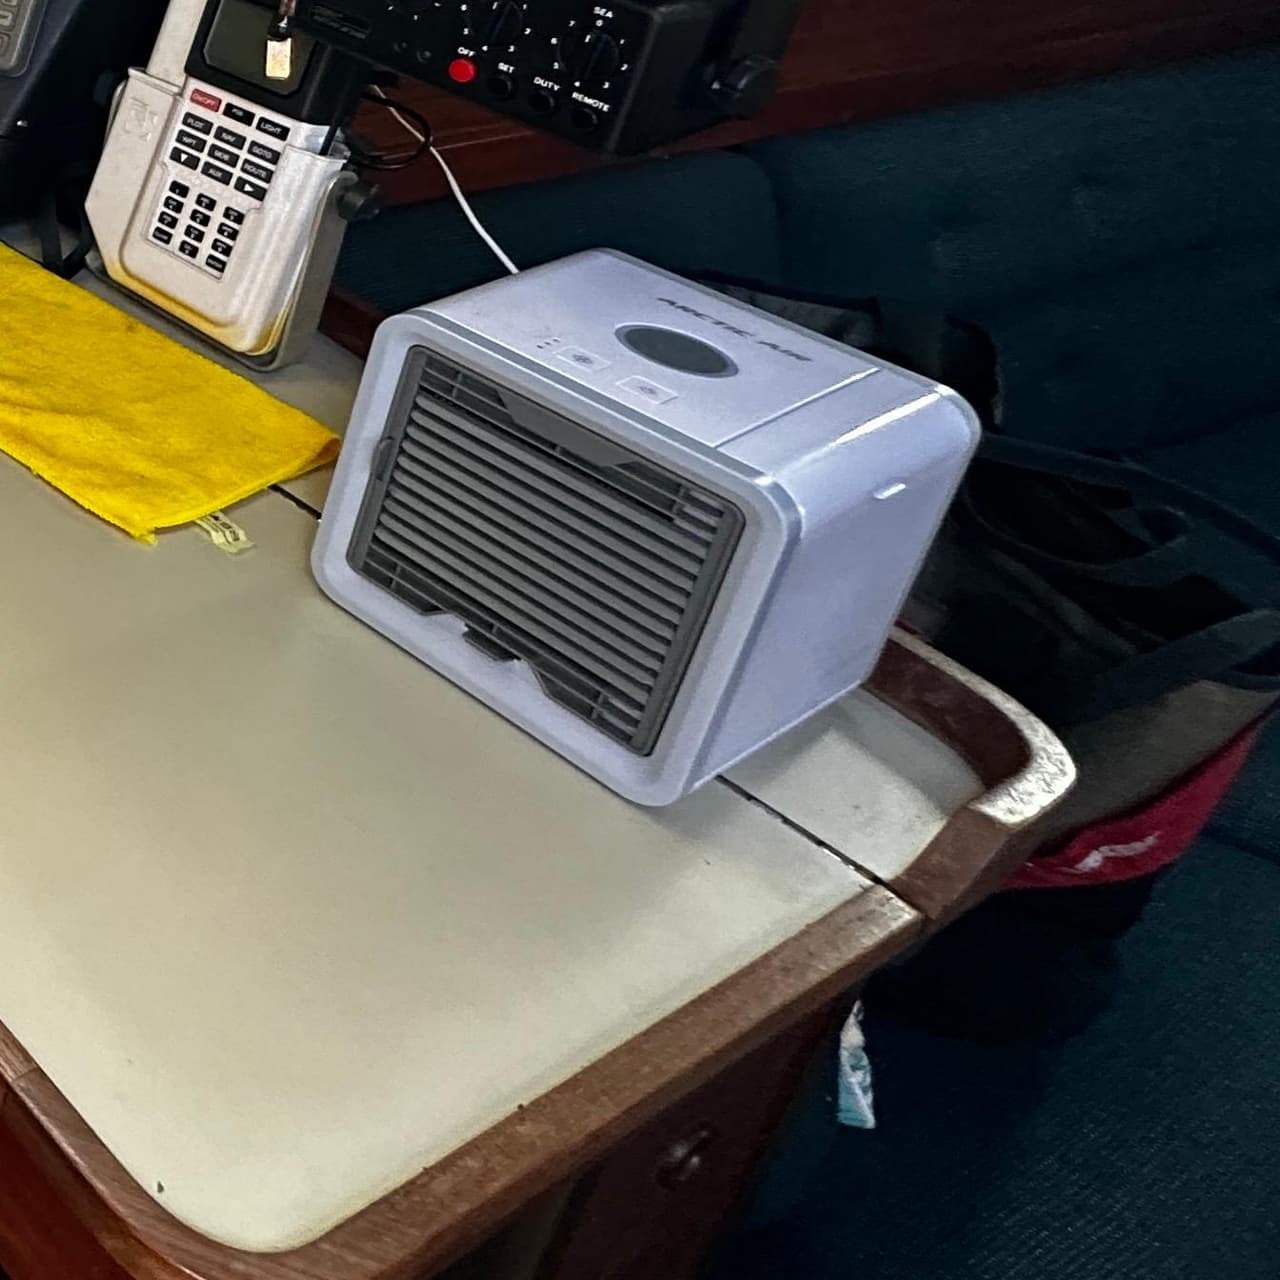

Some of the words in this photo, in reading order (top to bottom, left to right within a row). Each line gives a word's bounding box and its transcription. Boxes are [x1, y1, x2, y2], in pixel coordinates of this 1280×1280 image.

[593, 6, 614, 19] SEA
[457, 46, 476, 58] OFF
[498, 62, 516, 74] SET
[533, 76, 560, 92] DUTY
[571, 91, 611, 113] REMOTE
[260, 122, 283, 135] LIGHT
[244, 164, 268, 178] ROUTE
[656, 296, 755, 338] ARCTIC
[757, 340, 814, 362] AIR
